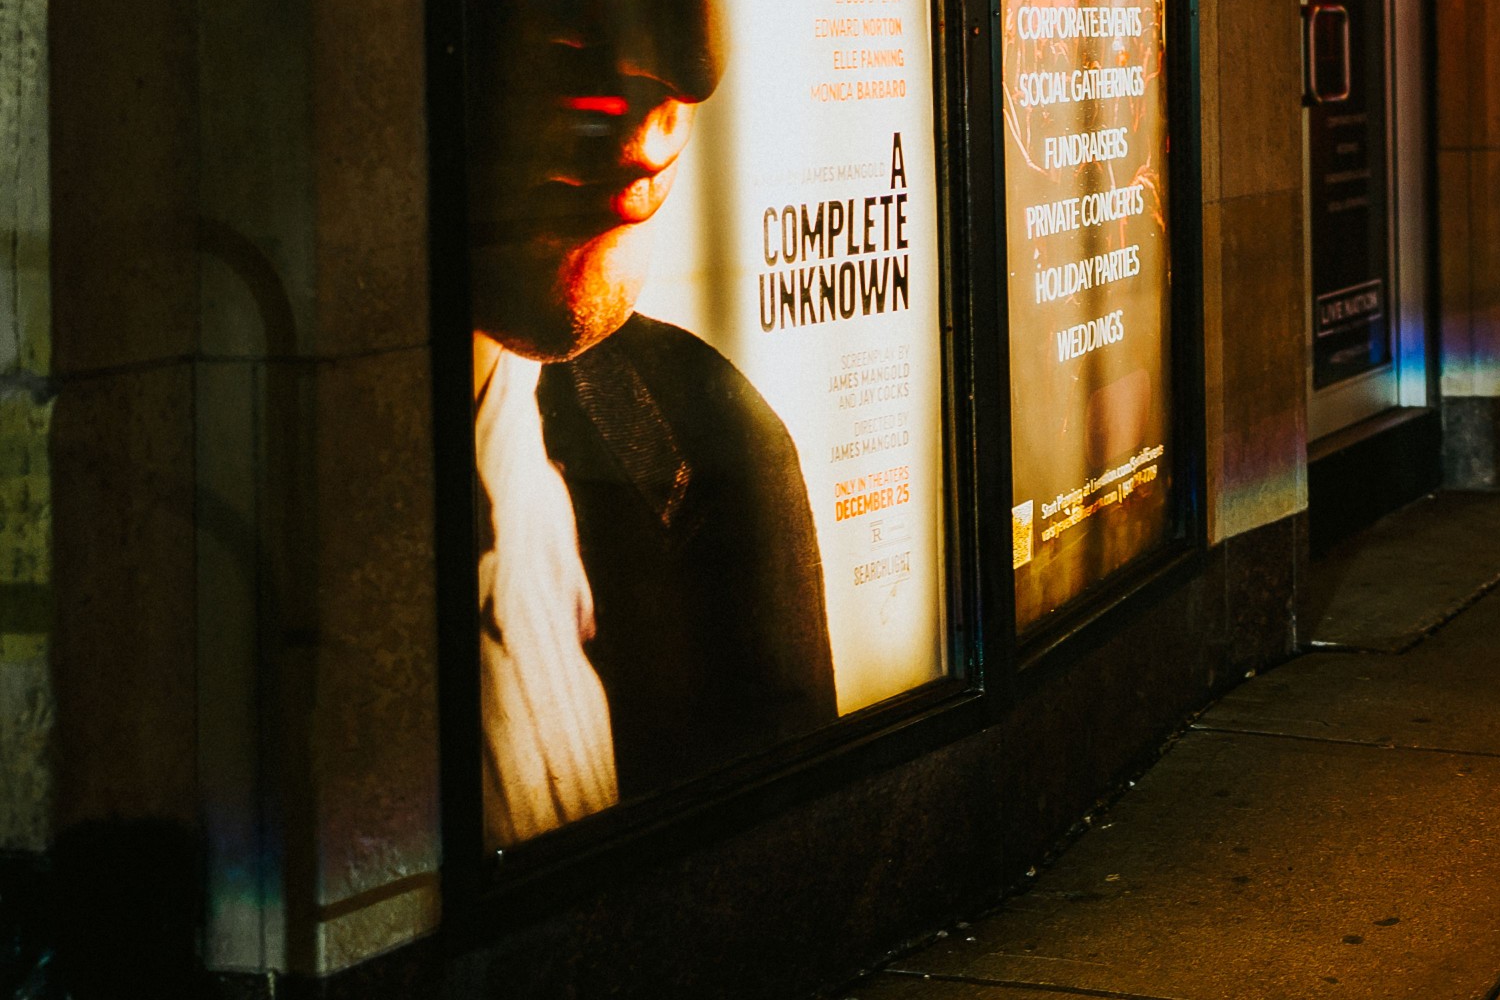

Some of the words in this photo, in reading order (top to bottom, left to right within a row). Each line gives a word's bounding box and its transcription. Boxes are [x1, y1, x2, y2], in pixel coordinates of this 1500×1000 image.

[1017, 6, 1099, 40] CORPORATE
[1100, 6, 1142, 37] EVENTS
[833, 50, 858, 69] ELLE
[856, 79, 906, 100] BARBARO
[1019, 72, 1070, 107] SOCIAL
[1071, 65, 1144, 102] GATHERINGS
[891, 132, 907, 189] A
[1044, 126, 1128, 170] FUNDRAISERS
[763, 193, 909, 267] COMPLETE
[1026, 197, 1080, 240] PRIVATE
[1081, 184, 1144, 227] CONCERTS
[759, 254, 909, 333] UNKNOWN
[1035, 257, 1094, 304] HOLIDAY
[1095, 244, 1140, 287] PARTIES
[1057, 309, 1124, 363] WEDDINGS
[828, 371, 859, 393] JAMES
[861, 362, 910, 387] MANGOLD
[830, 441, 861, 463] JAMES
[862, 430, 910, 456] MANGOLD
[835, 487, 894, 522] DECEMBER
[896, 482, 910, 505] 25
